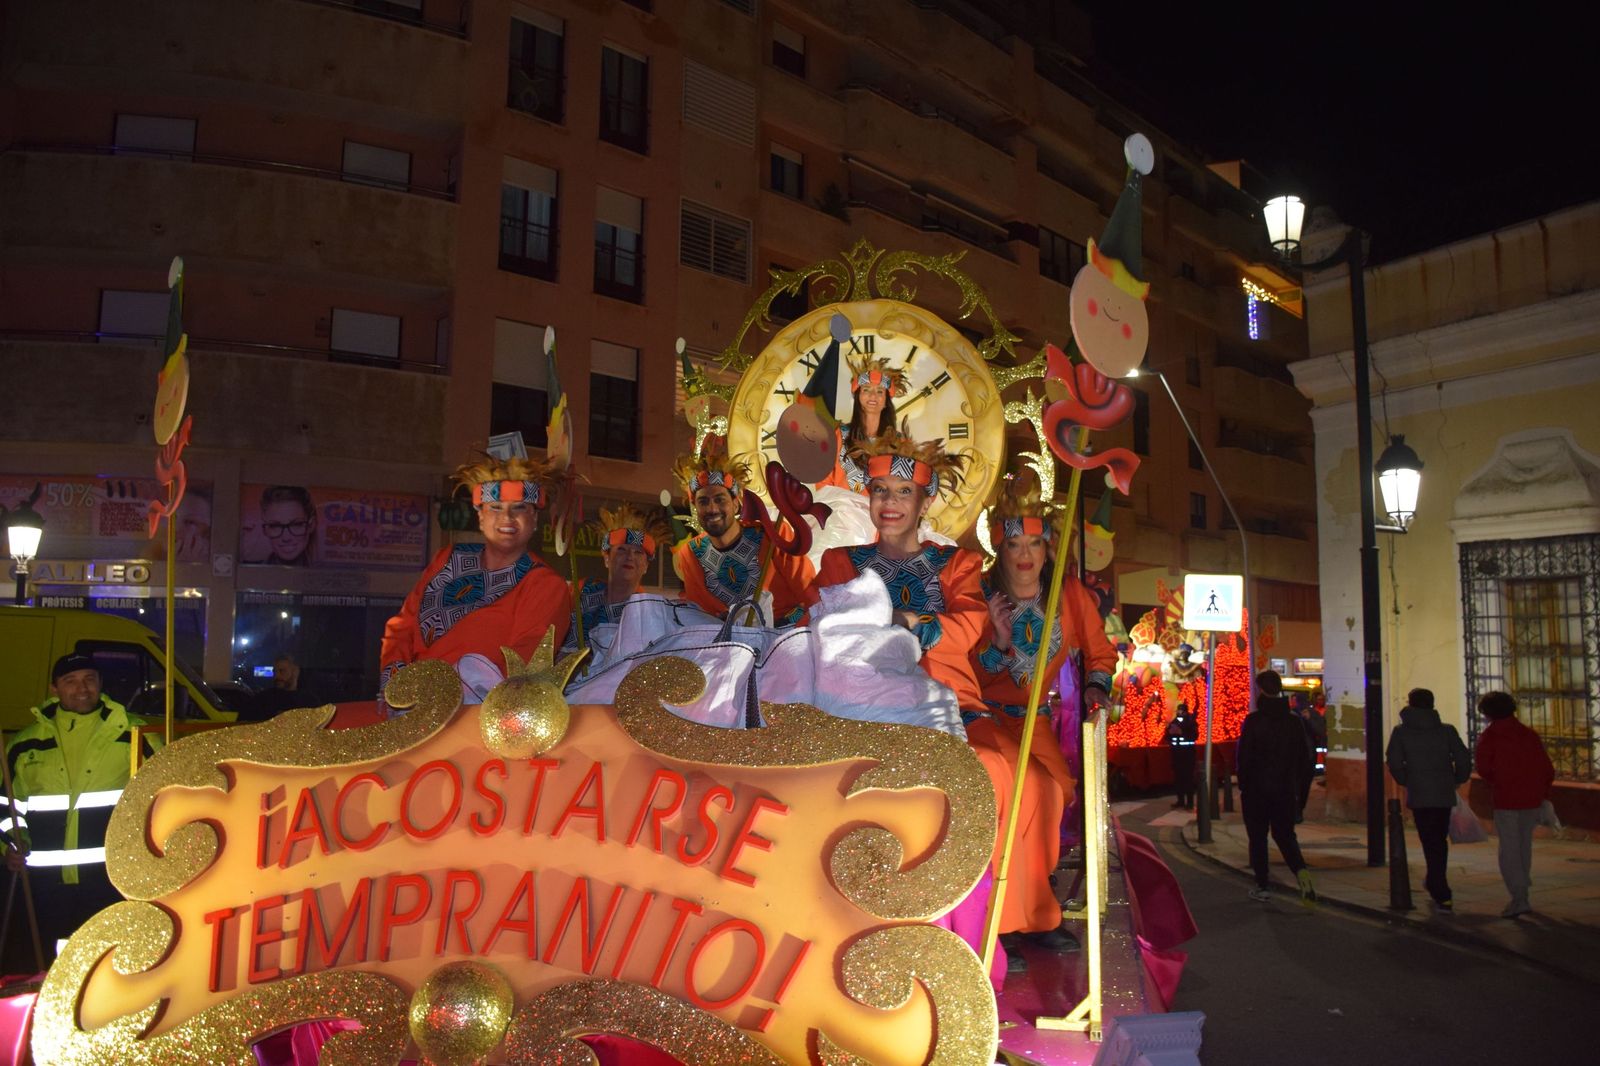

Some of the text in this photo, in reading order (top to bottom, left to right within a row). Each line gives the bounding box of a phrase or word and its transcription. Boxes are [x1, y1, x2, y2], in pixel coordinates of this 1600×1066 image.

[847, 335, 875, 356] XII
[905, 345, 918, 364] I
[46, 483, 95, 507] 50%
[325, 503, 424, 526] GALILEO
[325, 526, 369, 548] 50%
[42, 596, 84, 608] PRÓTESIS
[96, 598, 143, 609] OCULARES
[257, 758, 791, 888] ¡ACOSTARSE
[205, 870, 814, 1033] TEMPRANITO!
